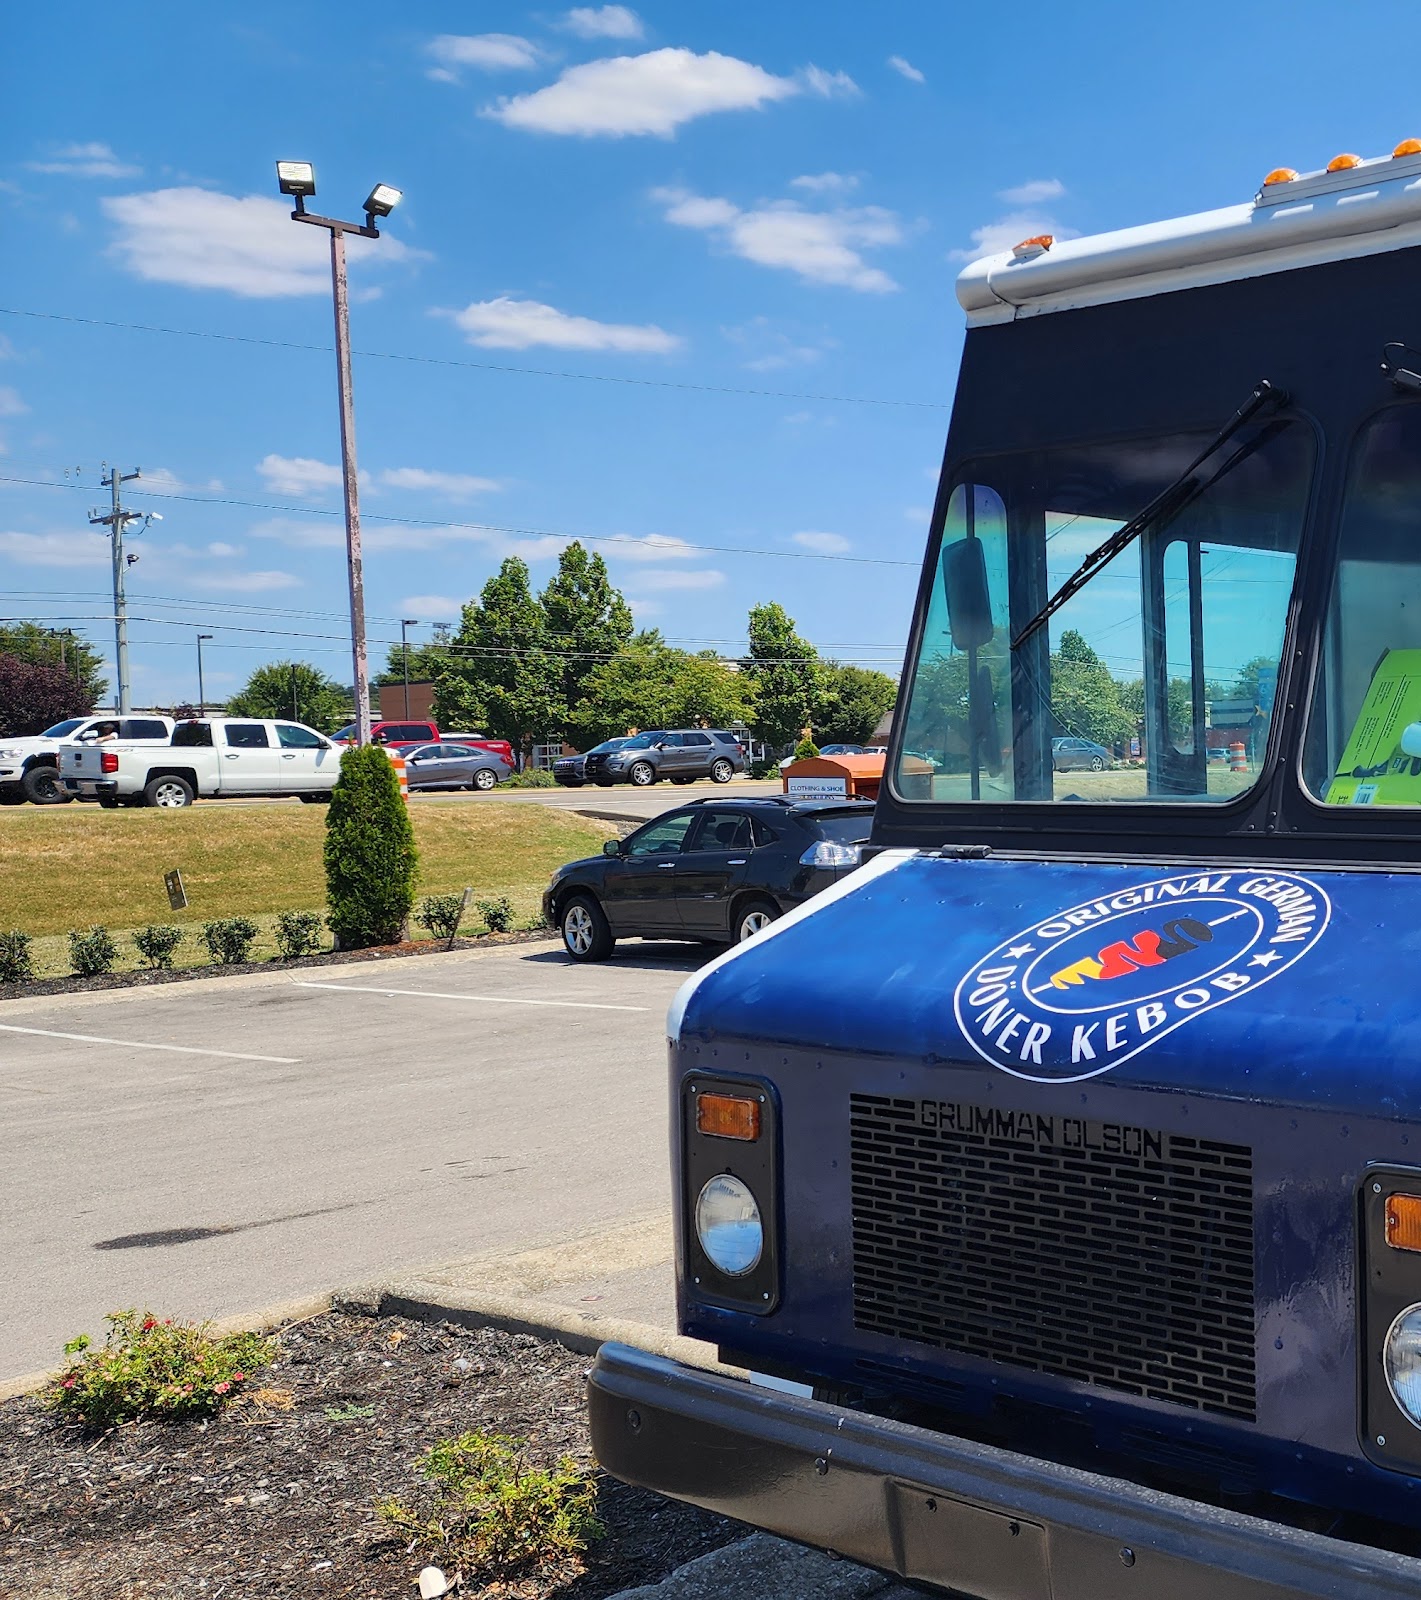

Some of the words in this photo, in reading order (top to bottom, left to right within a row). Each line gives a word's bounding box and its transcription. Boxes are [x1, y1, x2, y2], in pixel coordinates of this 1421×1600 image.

[1036, 875, 1232, 939] ORIGINAL
[1238, 876, 1316, 944] GERMAN
[968, 965, 1052, 1065] DÖNER
[1070, 972, 1252, 1064] KEBOB
[921, 1099, 1054, 1143] GRUMMAN
[1063, 1118, 1163, 1160] OLSON
